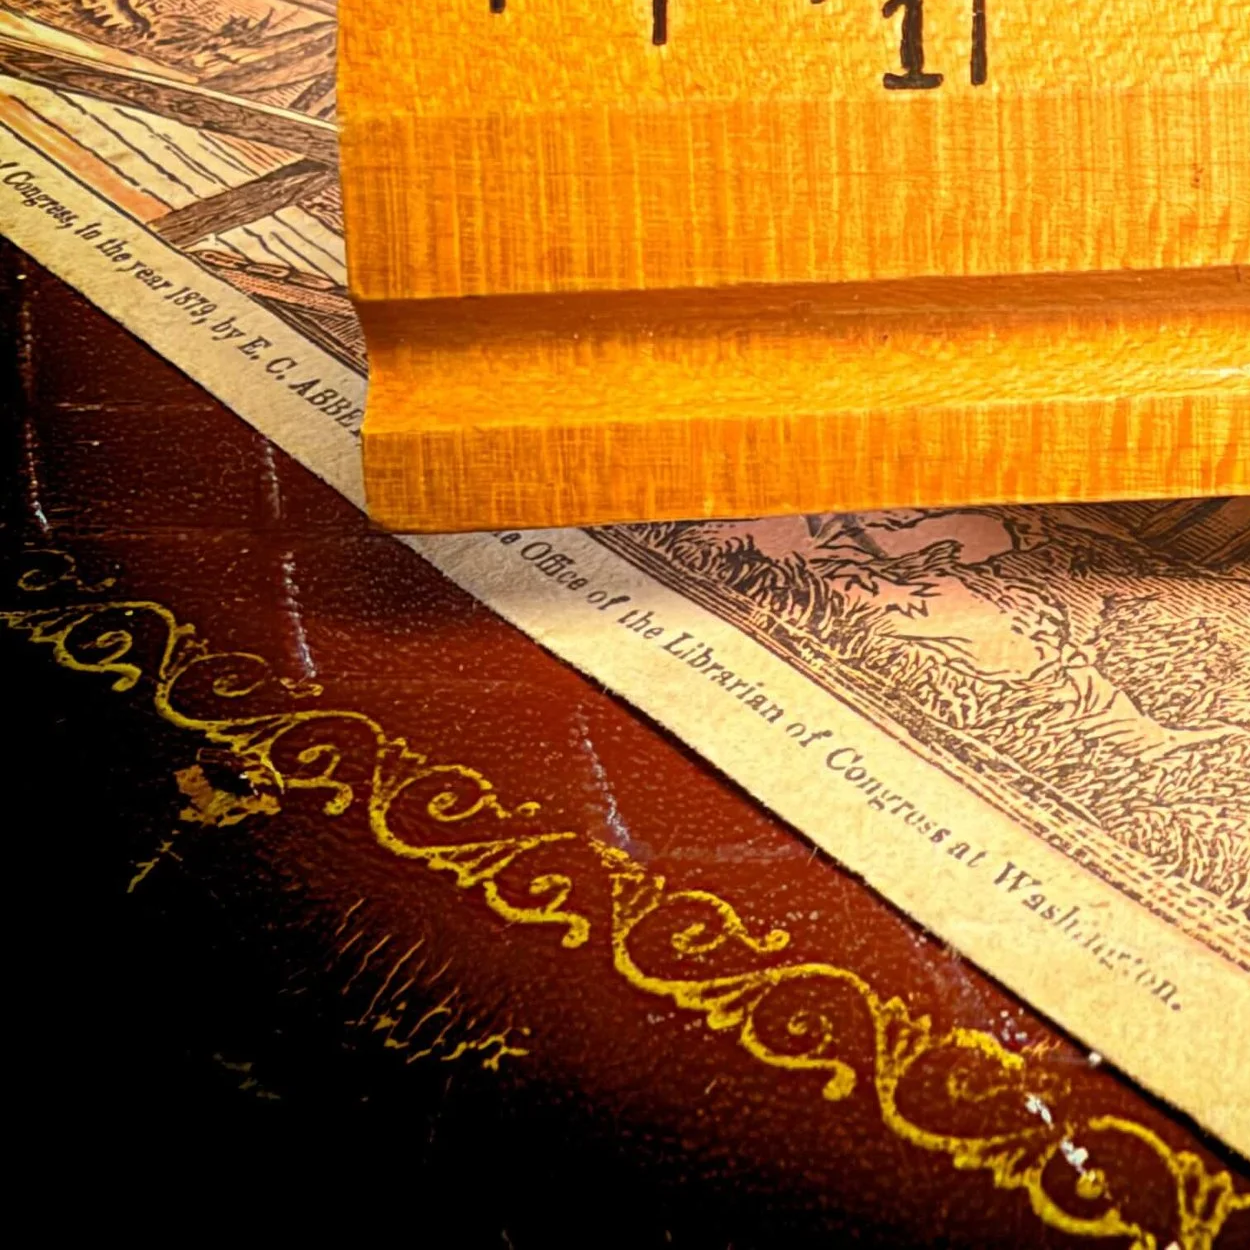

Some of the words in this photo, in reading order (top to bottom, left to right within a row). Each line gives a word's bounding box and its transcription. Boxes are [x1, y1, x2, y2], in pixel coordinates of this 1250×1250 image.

[3, 171, 80, 229] Congress,
[96, 238, 133, 263] the
[115, 260, 174, 290] year
[165, 286, 217, 325] 1879,
[211, 316, 246, 341] by
[236, 335, 273, 360] E.
[265, 356, 298, 380] C.
[520, 541, 589, 591] Office
[587, 590, 631, 610] of
[617, 609, 665, 639] the
[662, 632, 785, 723] Librarian
[786, 722, 834, 747] of
[825, 747, 952, 844] Congress
[947, 841, 989, 868] at
